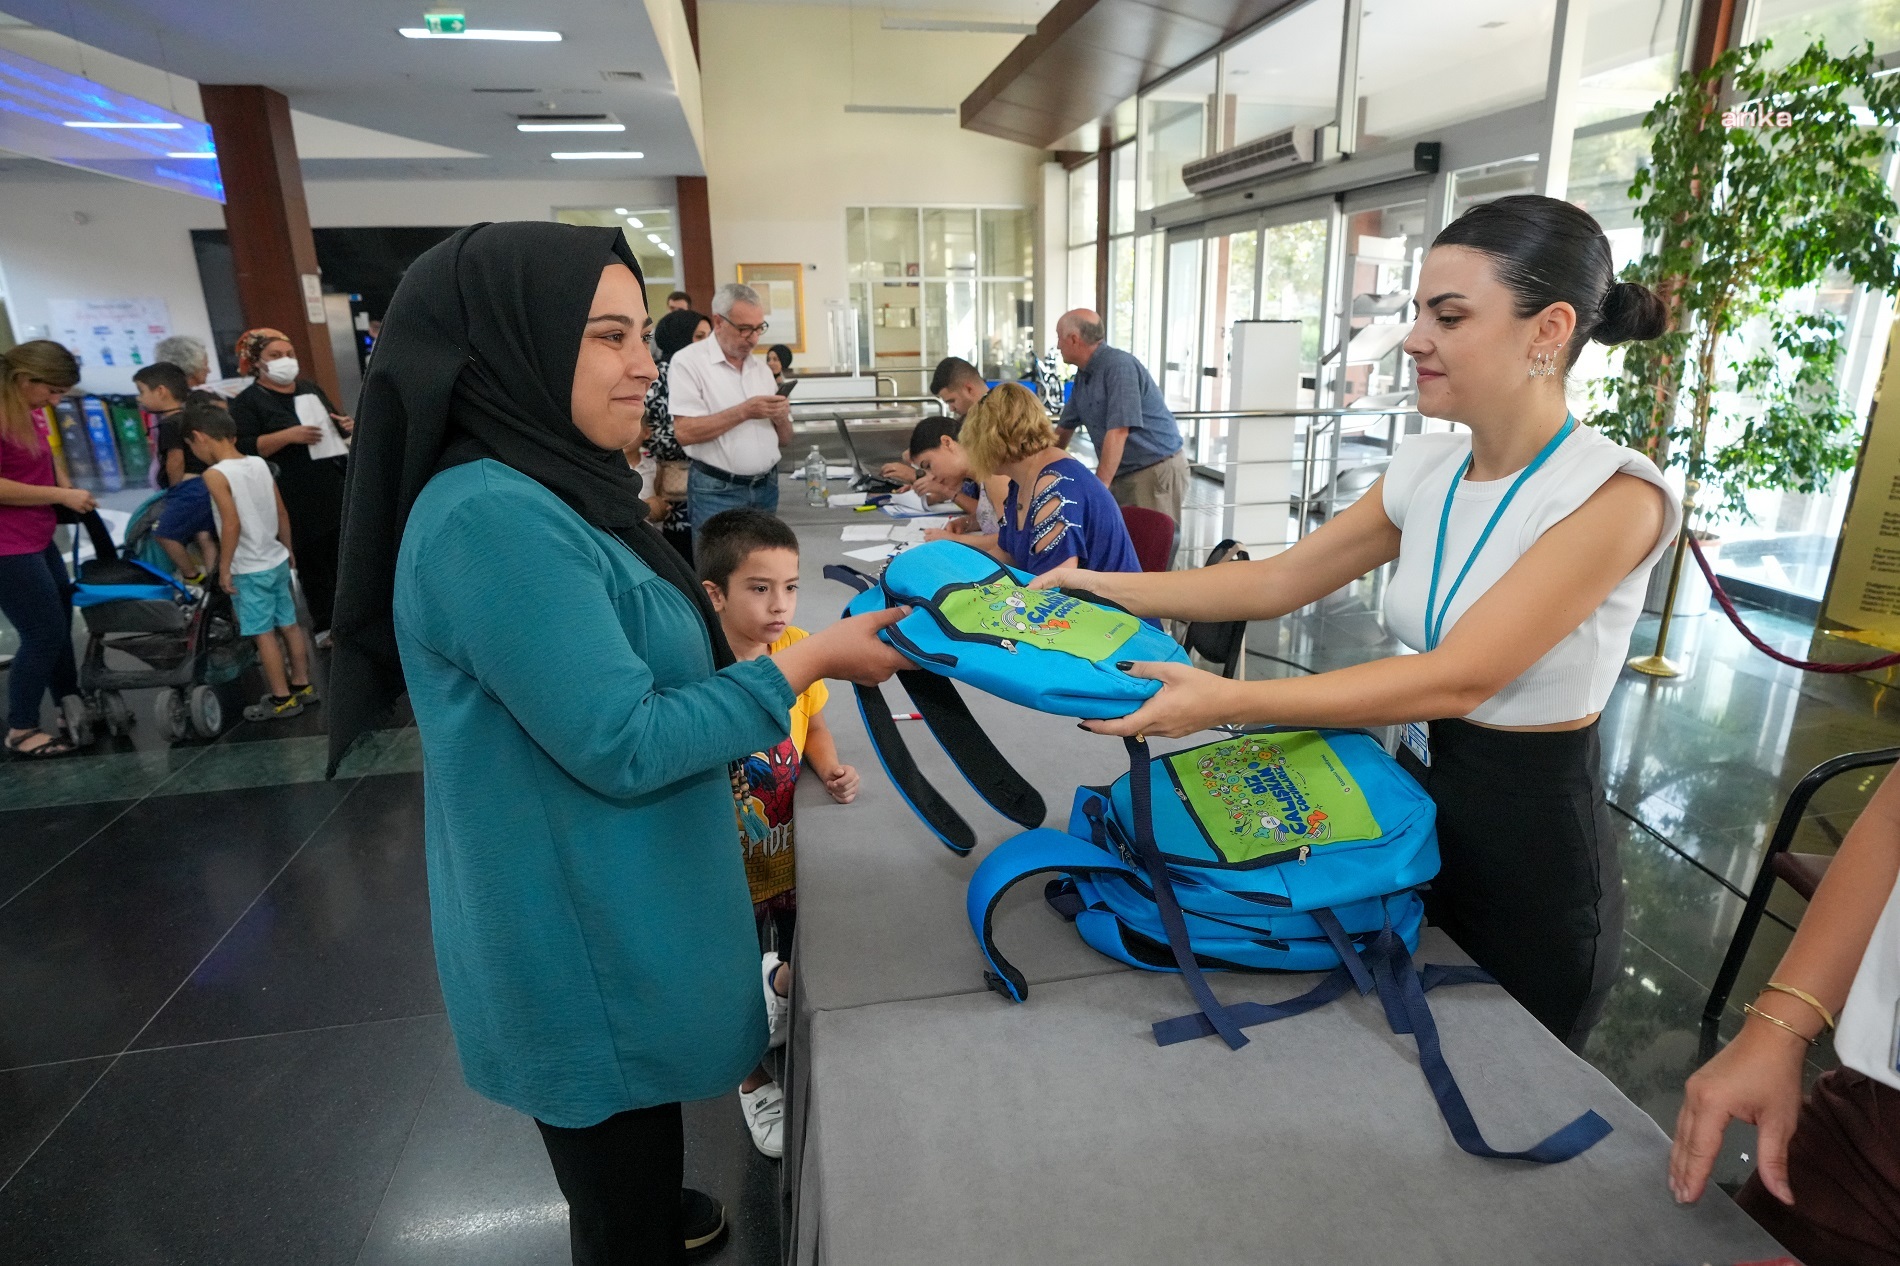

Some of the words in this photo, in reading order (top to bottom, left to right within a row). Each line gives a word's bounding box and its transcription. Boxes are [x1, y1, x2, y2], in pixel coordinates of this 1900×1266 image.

[1243, 774, 1269, 795] BİZ
[1257, 766, 1308, 835] ÇALIŞKAN
[755, 1096, 768, 1111] NIKE
